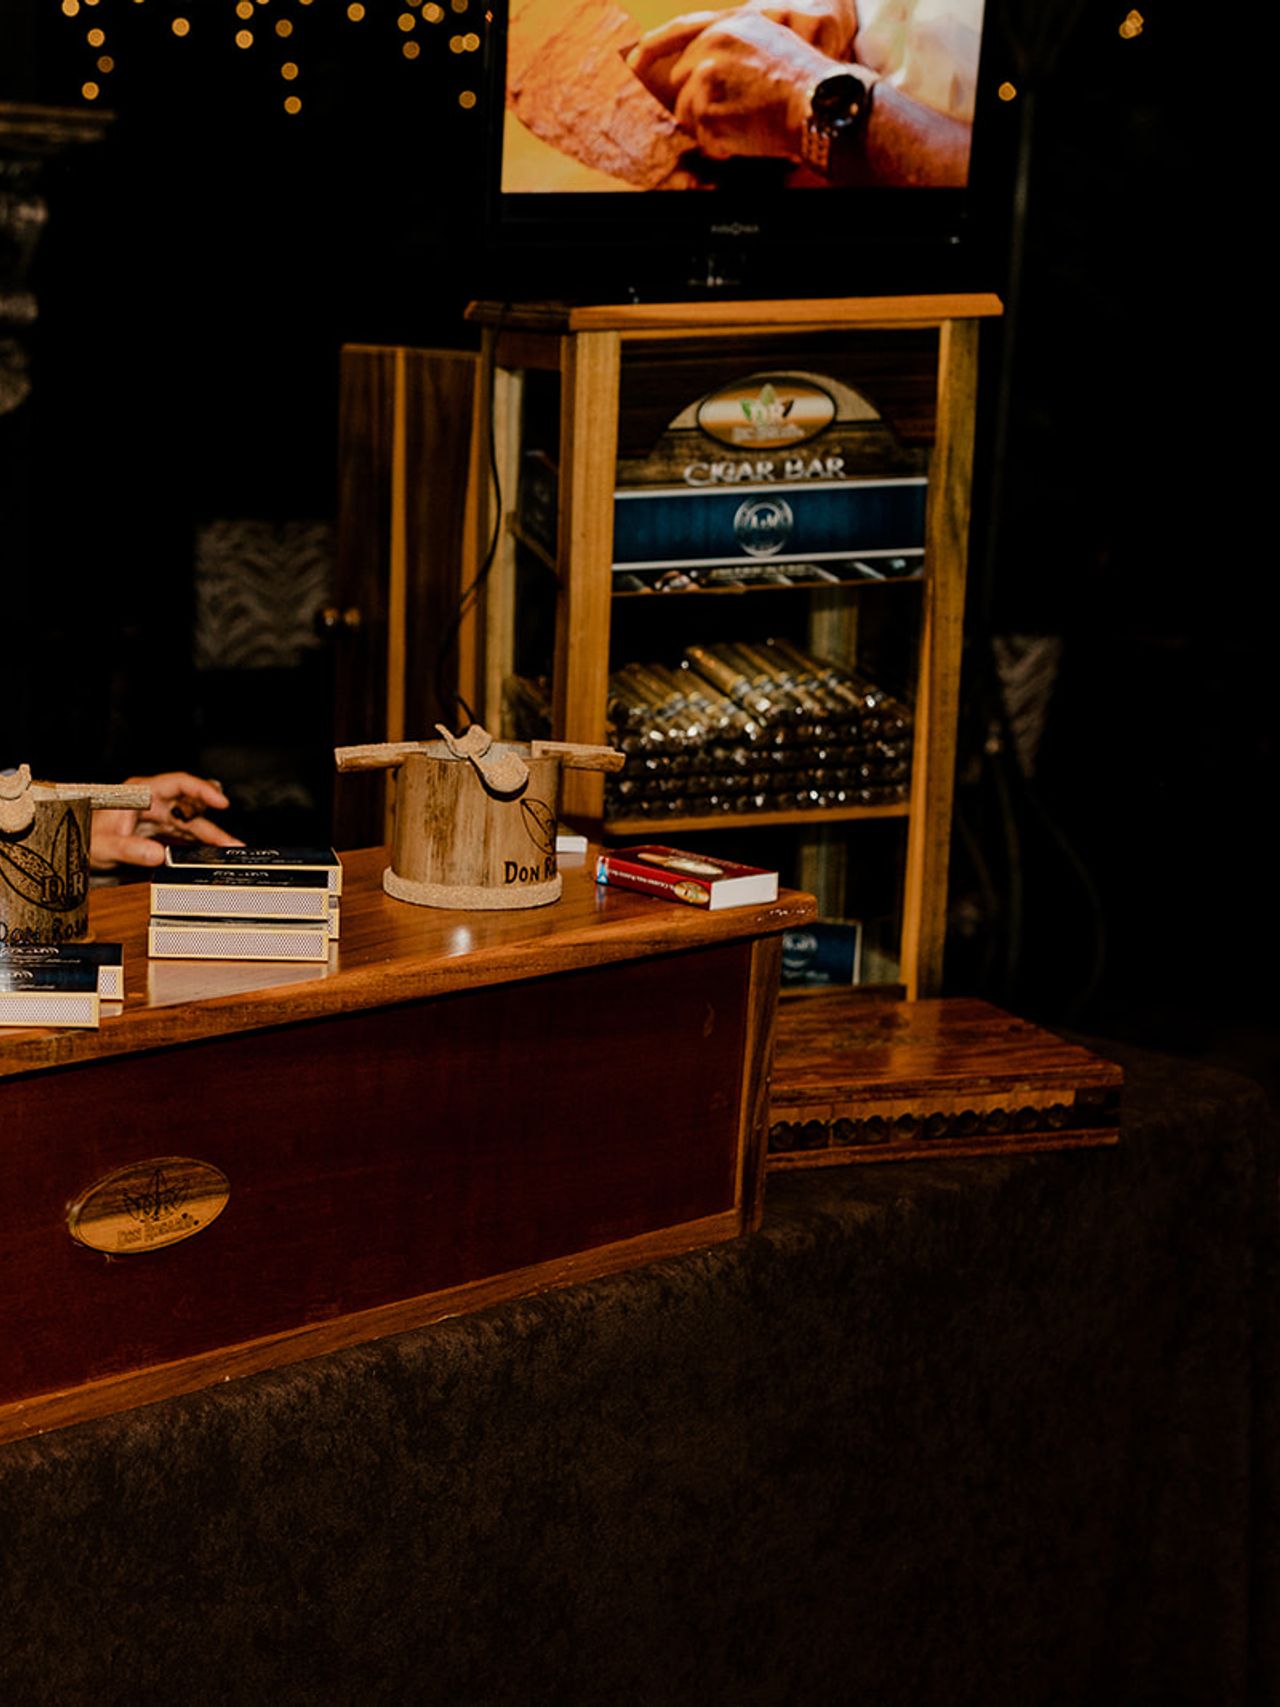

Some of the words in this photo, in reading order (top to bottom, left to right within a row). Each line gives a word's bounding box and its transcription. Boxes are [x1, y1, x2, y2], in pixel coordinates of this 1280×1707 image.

[683, 460, 776, 487] CIGAR
[784, 456, 846, 480] BAR
[504, 861, 541, 884] DON
